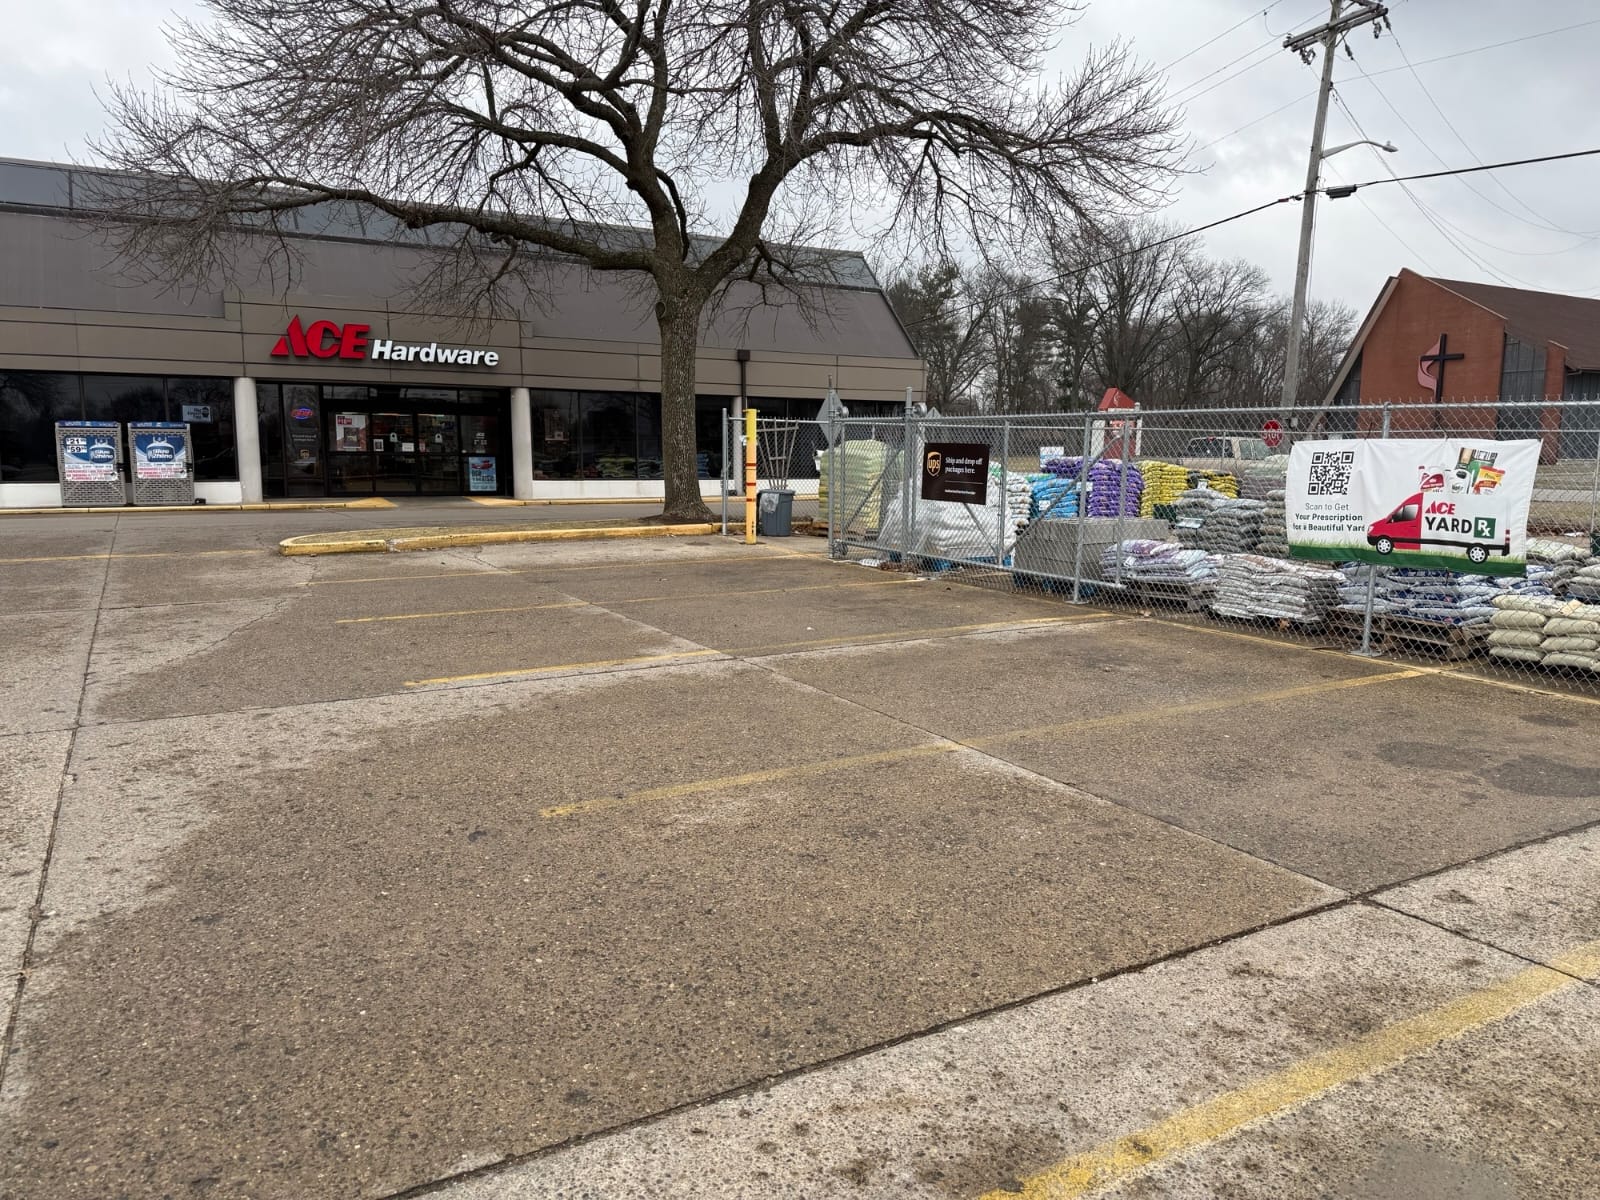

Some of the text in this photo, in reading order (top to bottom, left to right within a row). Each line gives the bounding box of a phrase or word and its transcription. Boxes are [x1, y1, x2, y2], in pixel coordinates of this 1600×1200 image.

[271, 314, 499, 366] ACE Hardware
[1263, 428, 1281, 440] STOP
[945, 457, 955, 465] Ship
[1305, 502, 1349, 511] Scan to Get
[1425, 501, 1456, 515] ACE
[1295, 513, 1363, 522] Your Prescription
[1308, 523, 1344, 532] Beautiful
[1425, 516, 1472, 534] YARD
